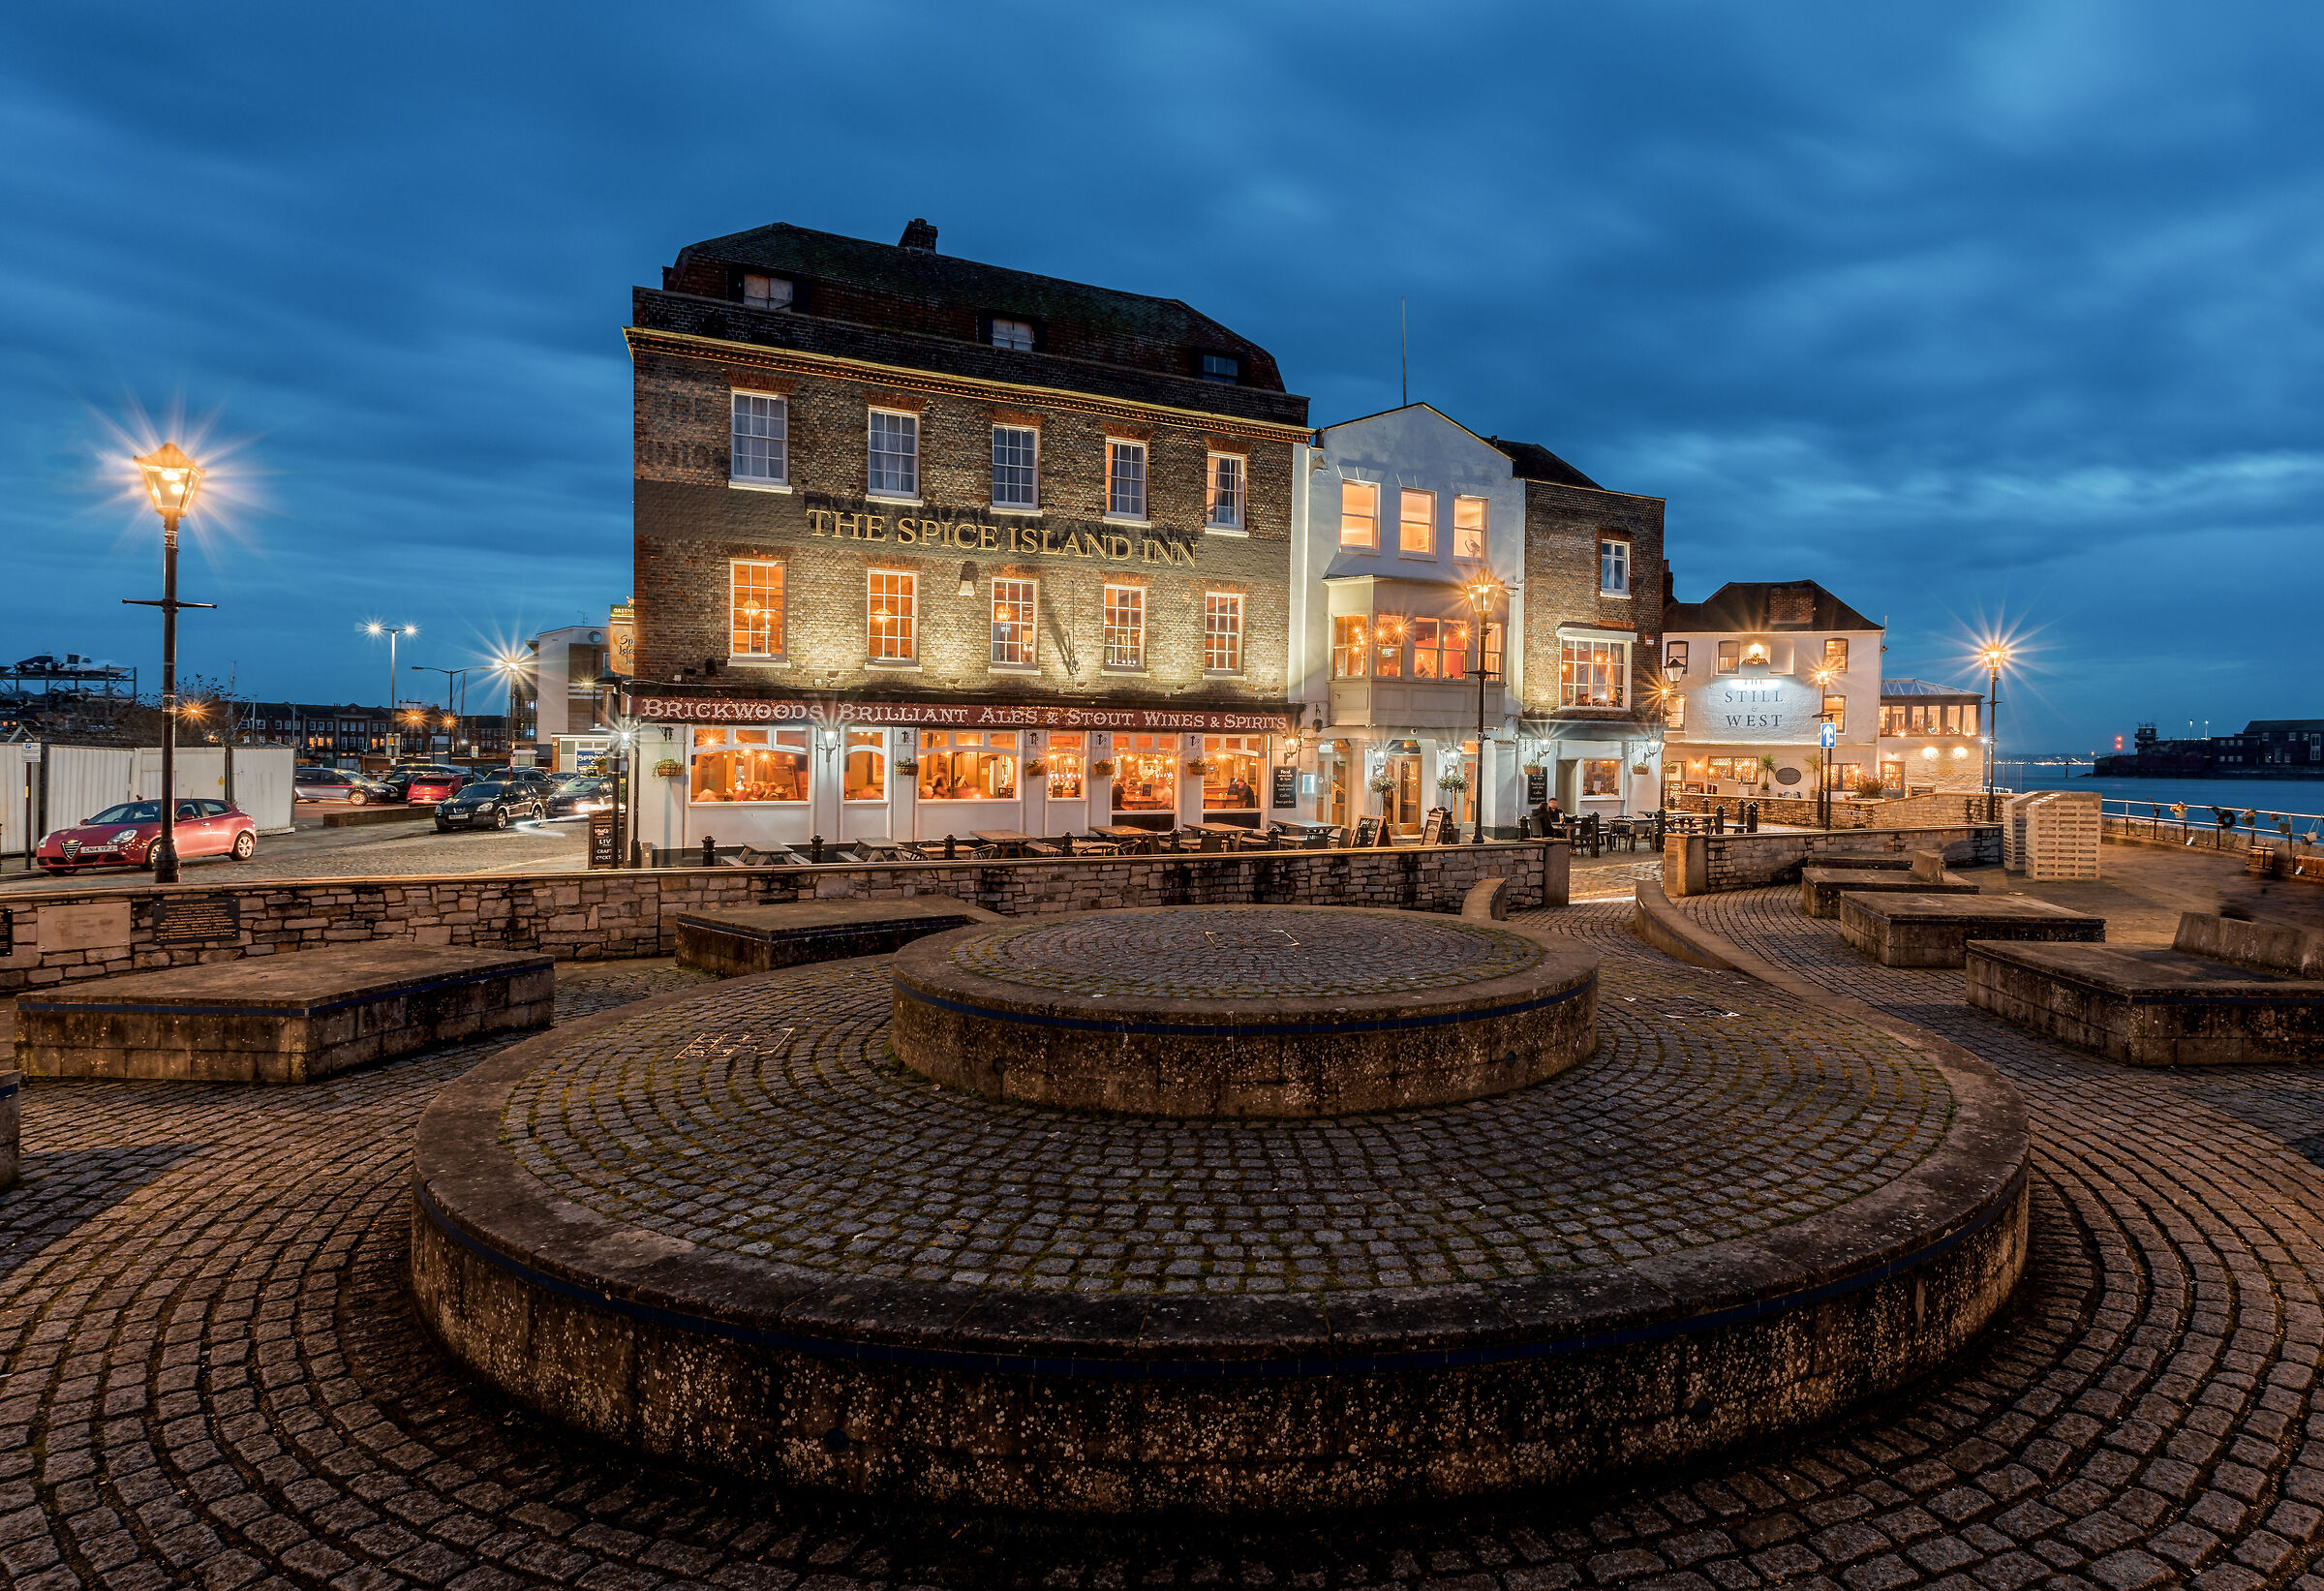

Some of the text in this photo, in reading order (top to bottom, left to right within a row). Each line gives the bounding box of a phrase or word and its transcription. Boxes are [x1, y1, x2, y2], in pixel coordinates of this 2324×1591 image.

[807, 508, 1198, 566] THE SPICE ISLAND INN
[619, 645, 634, 655] Isla
[1725, 690, 1784, 703] STILL
[1046, 711, 1058, 724] &
[1210, 716, 1220, 728] &
[1726, 715, 1783, 727] WEST
